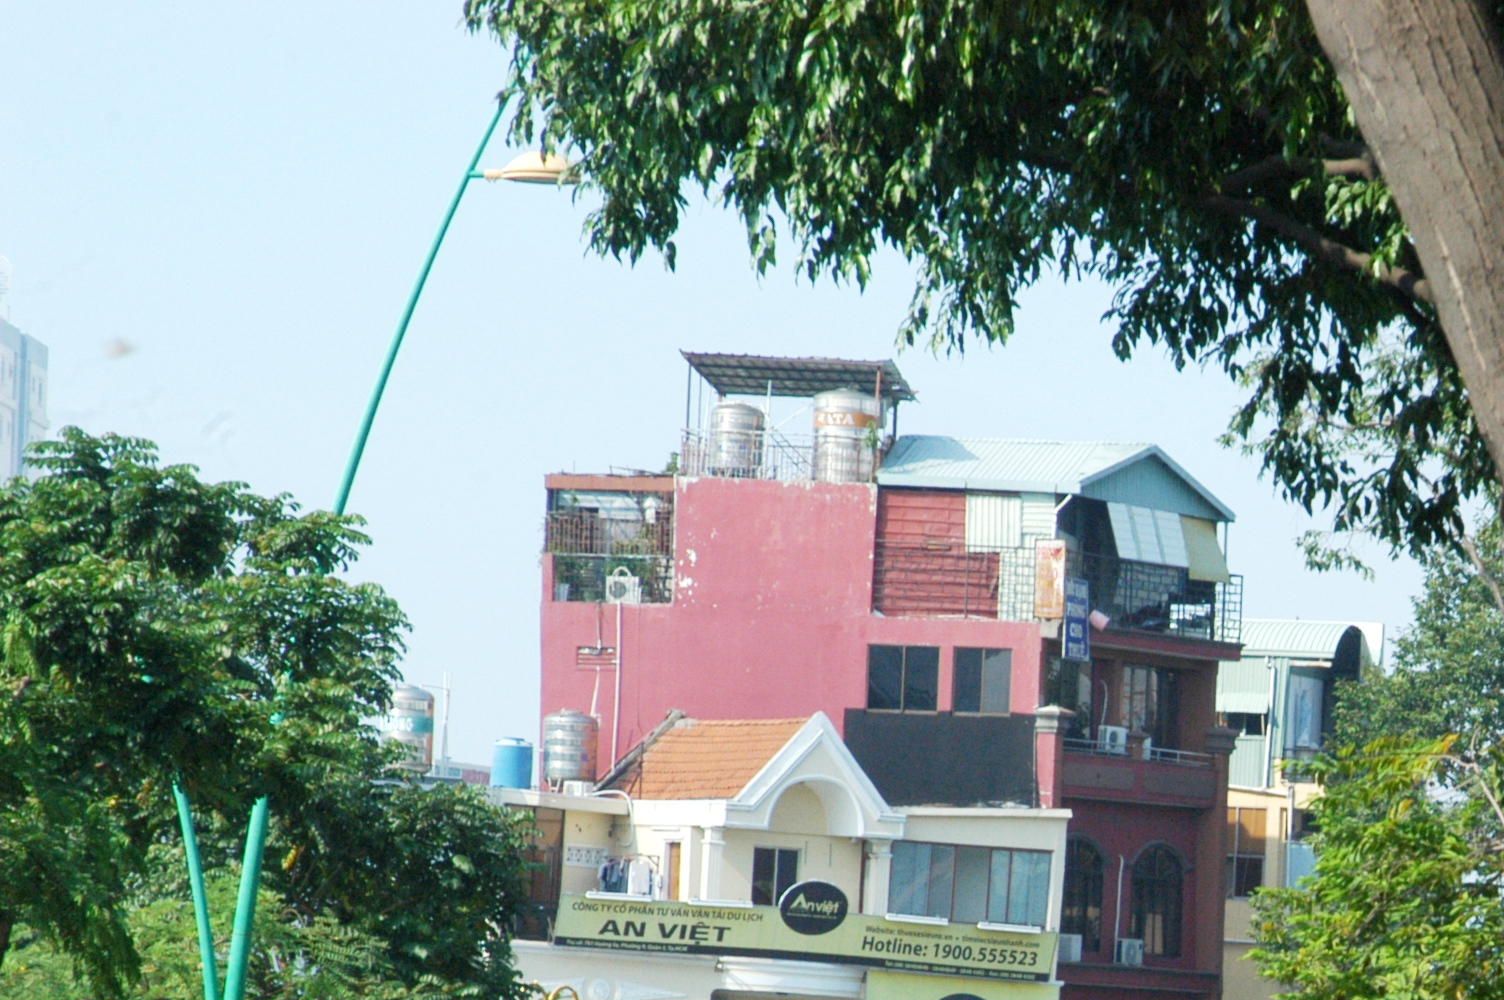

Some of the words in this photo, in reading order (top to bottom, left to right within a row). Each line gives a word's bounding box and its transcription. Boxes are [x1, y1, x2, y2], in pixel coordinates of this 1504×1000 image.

[572, 901, 599, 912] CÔNG
[600, 904, 612, 912] TY
[628, 905, 654, 916] PHẦN
[727, 912, 741, 921] DU
[743, 912, 764, 923] LỊCH
[598, 919, 646, 937] AN
[658, 921, 732, 944] VIỆT
[862, 936, 927, 957] Hotline:
[933, 943, 1038, 966] 1900.555523
